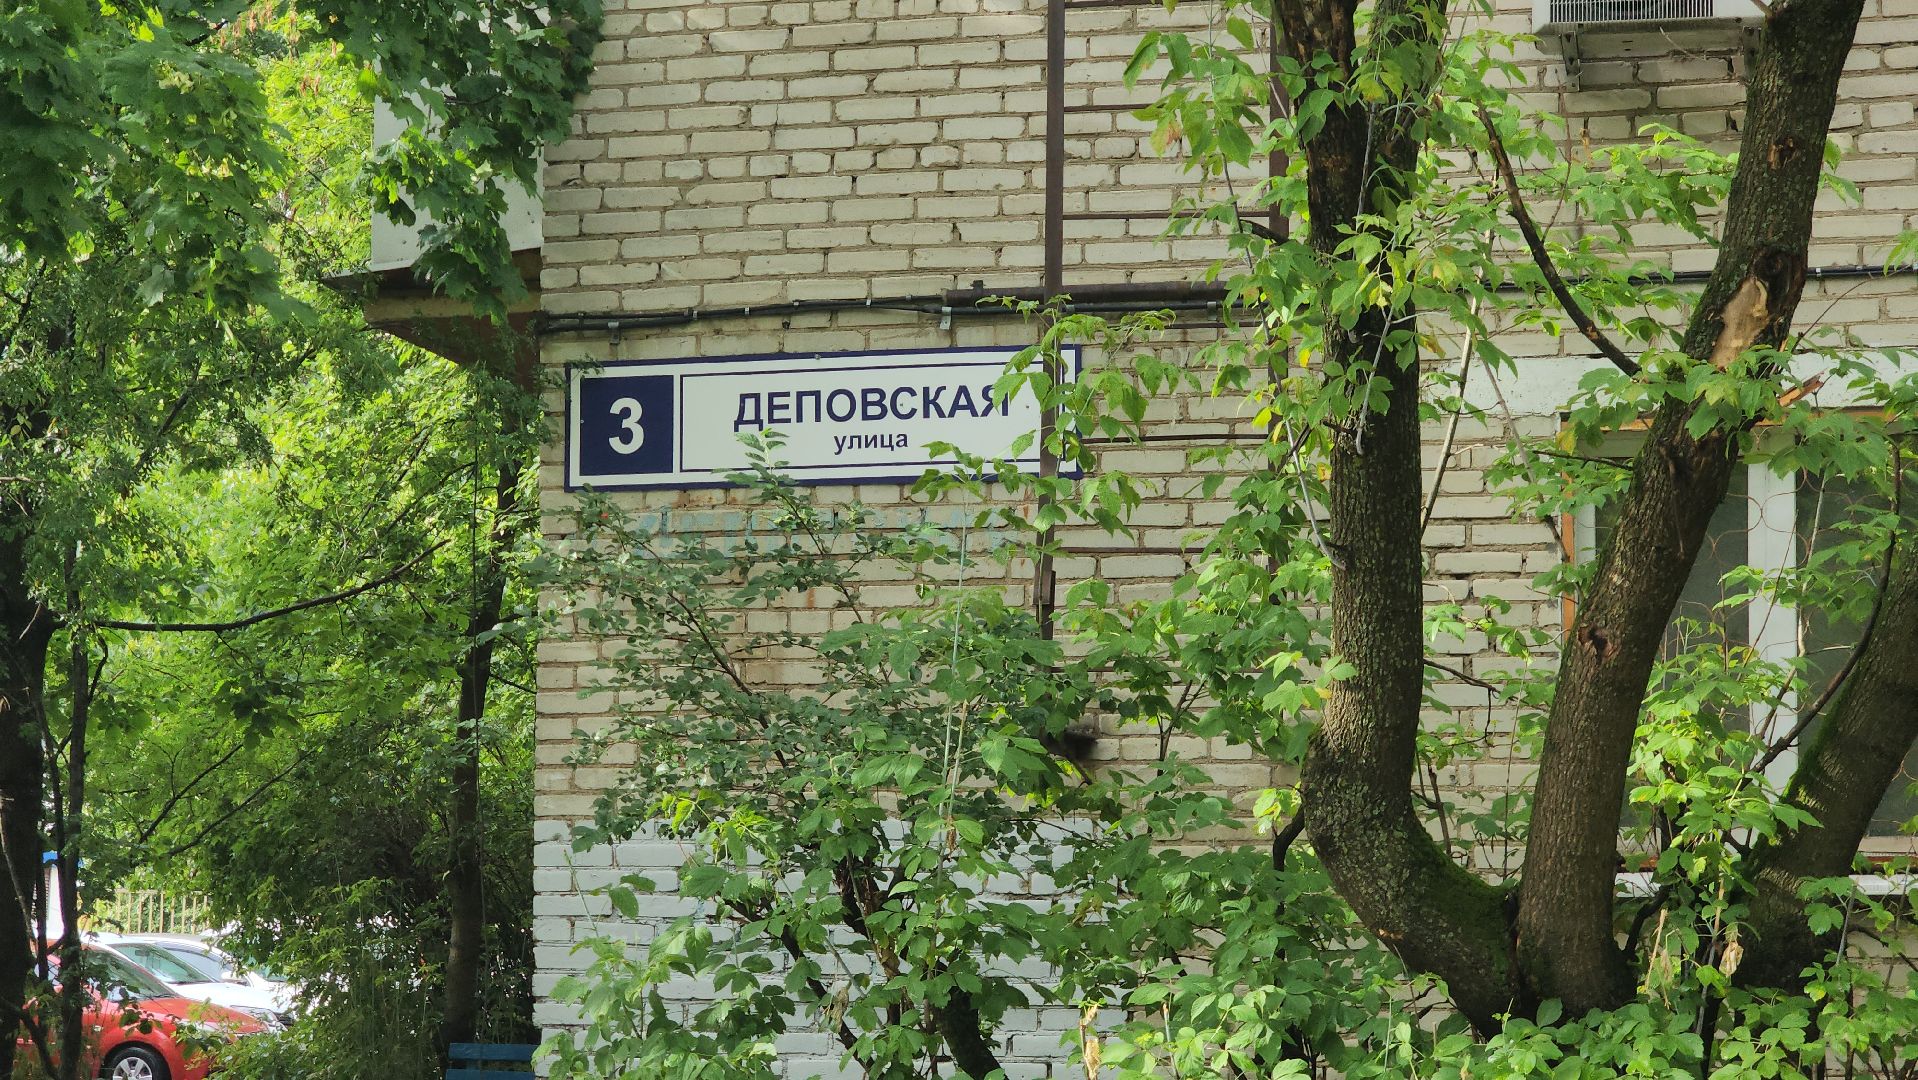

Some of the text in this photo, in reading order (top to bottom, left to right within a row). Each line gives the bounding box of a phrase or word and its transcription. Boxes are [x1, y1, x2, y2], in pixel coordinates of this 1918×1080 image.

[608, 397, 645, 455] 3
[733, 384, 1009, 433] ДЕПОВСКАЯ
[833, 432, 909, 456] улица
